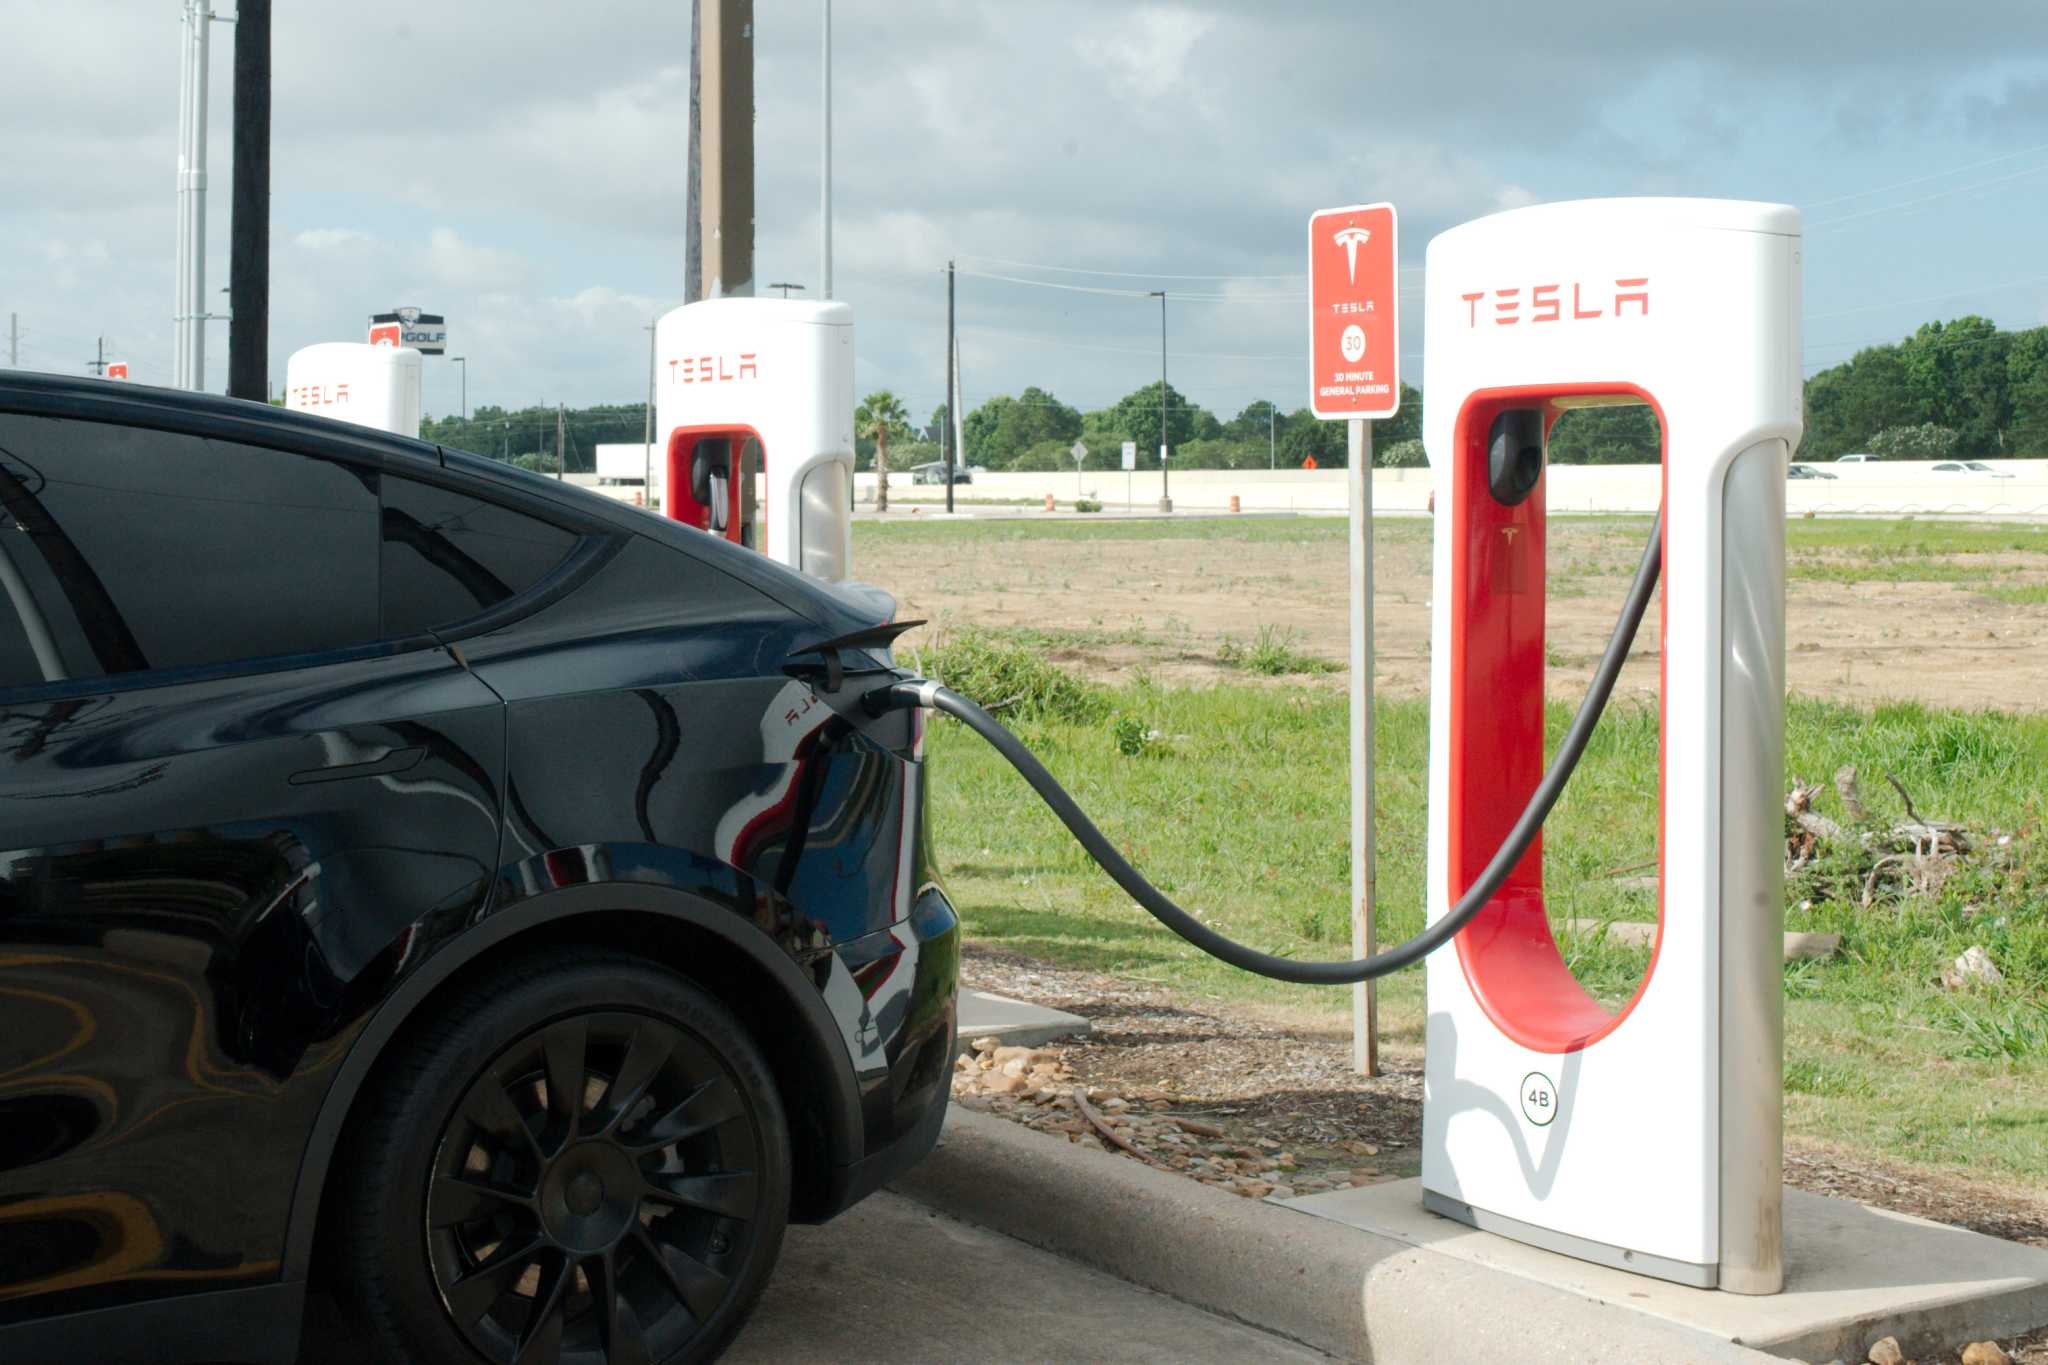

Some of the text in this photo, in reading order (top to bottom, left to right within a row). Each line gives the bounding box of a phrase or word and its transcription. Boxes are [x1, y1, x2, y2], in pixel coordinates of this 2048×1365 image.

[1332, 300, 1375, 313] TESLA
[1461, 277, 1649, 329] TESLA
[1345, 335, 1362, 351] 30
[668, 353, 757, 385] TESLA
[1345, 371, 1374, 381] MINUTE
[293, 383, 349, 406] TESLA
[1320, 384, 1390, 397] GENERAL PARKING
[1528, 1089, 1549, 1107] 4B
